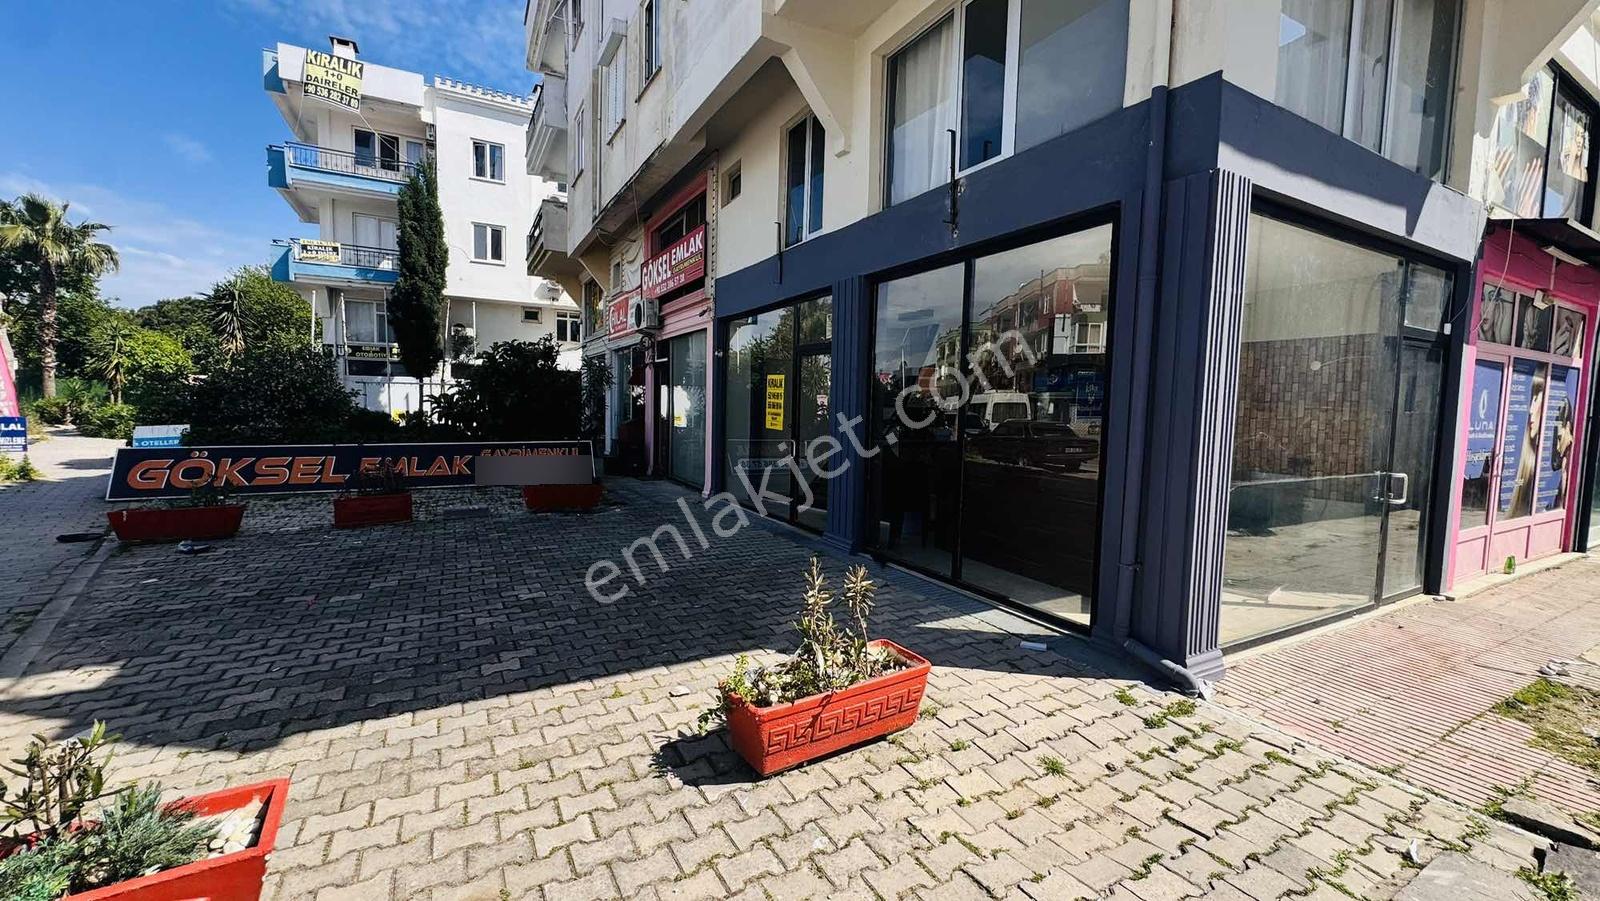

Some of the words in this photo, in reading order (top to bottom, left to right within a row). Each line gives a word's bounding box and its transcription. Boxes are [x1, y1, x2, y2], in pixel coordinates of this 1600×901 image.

[306, 74, 358, 97] DAİRELER
[324, 70, 343, 81] 1+0
[641, 252, 672, 291] GÖKSEL
[671, 231, 704, 266] EMLAK
[127, 450, 351, 490] GÖKSEL
[359, 455, 473, 477] EMLAK
